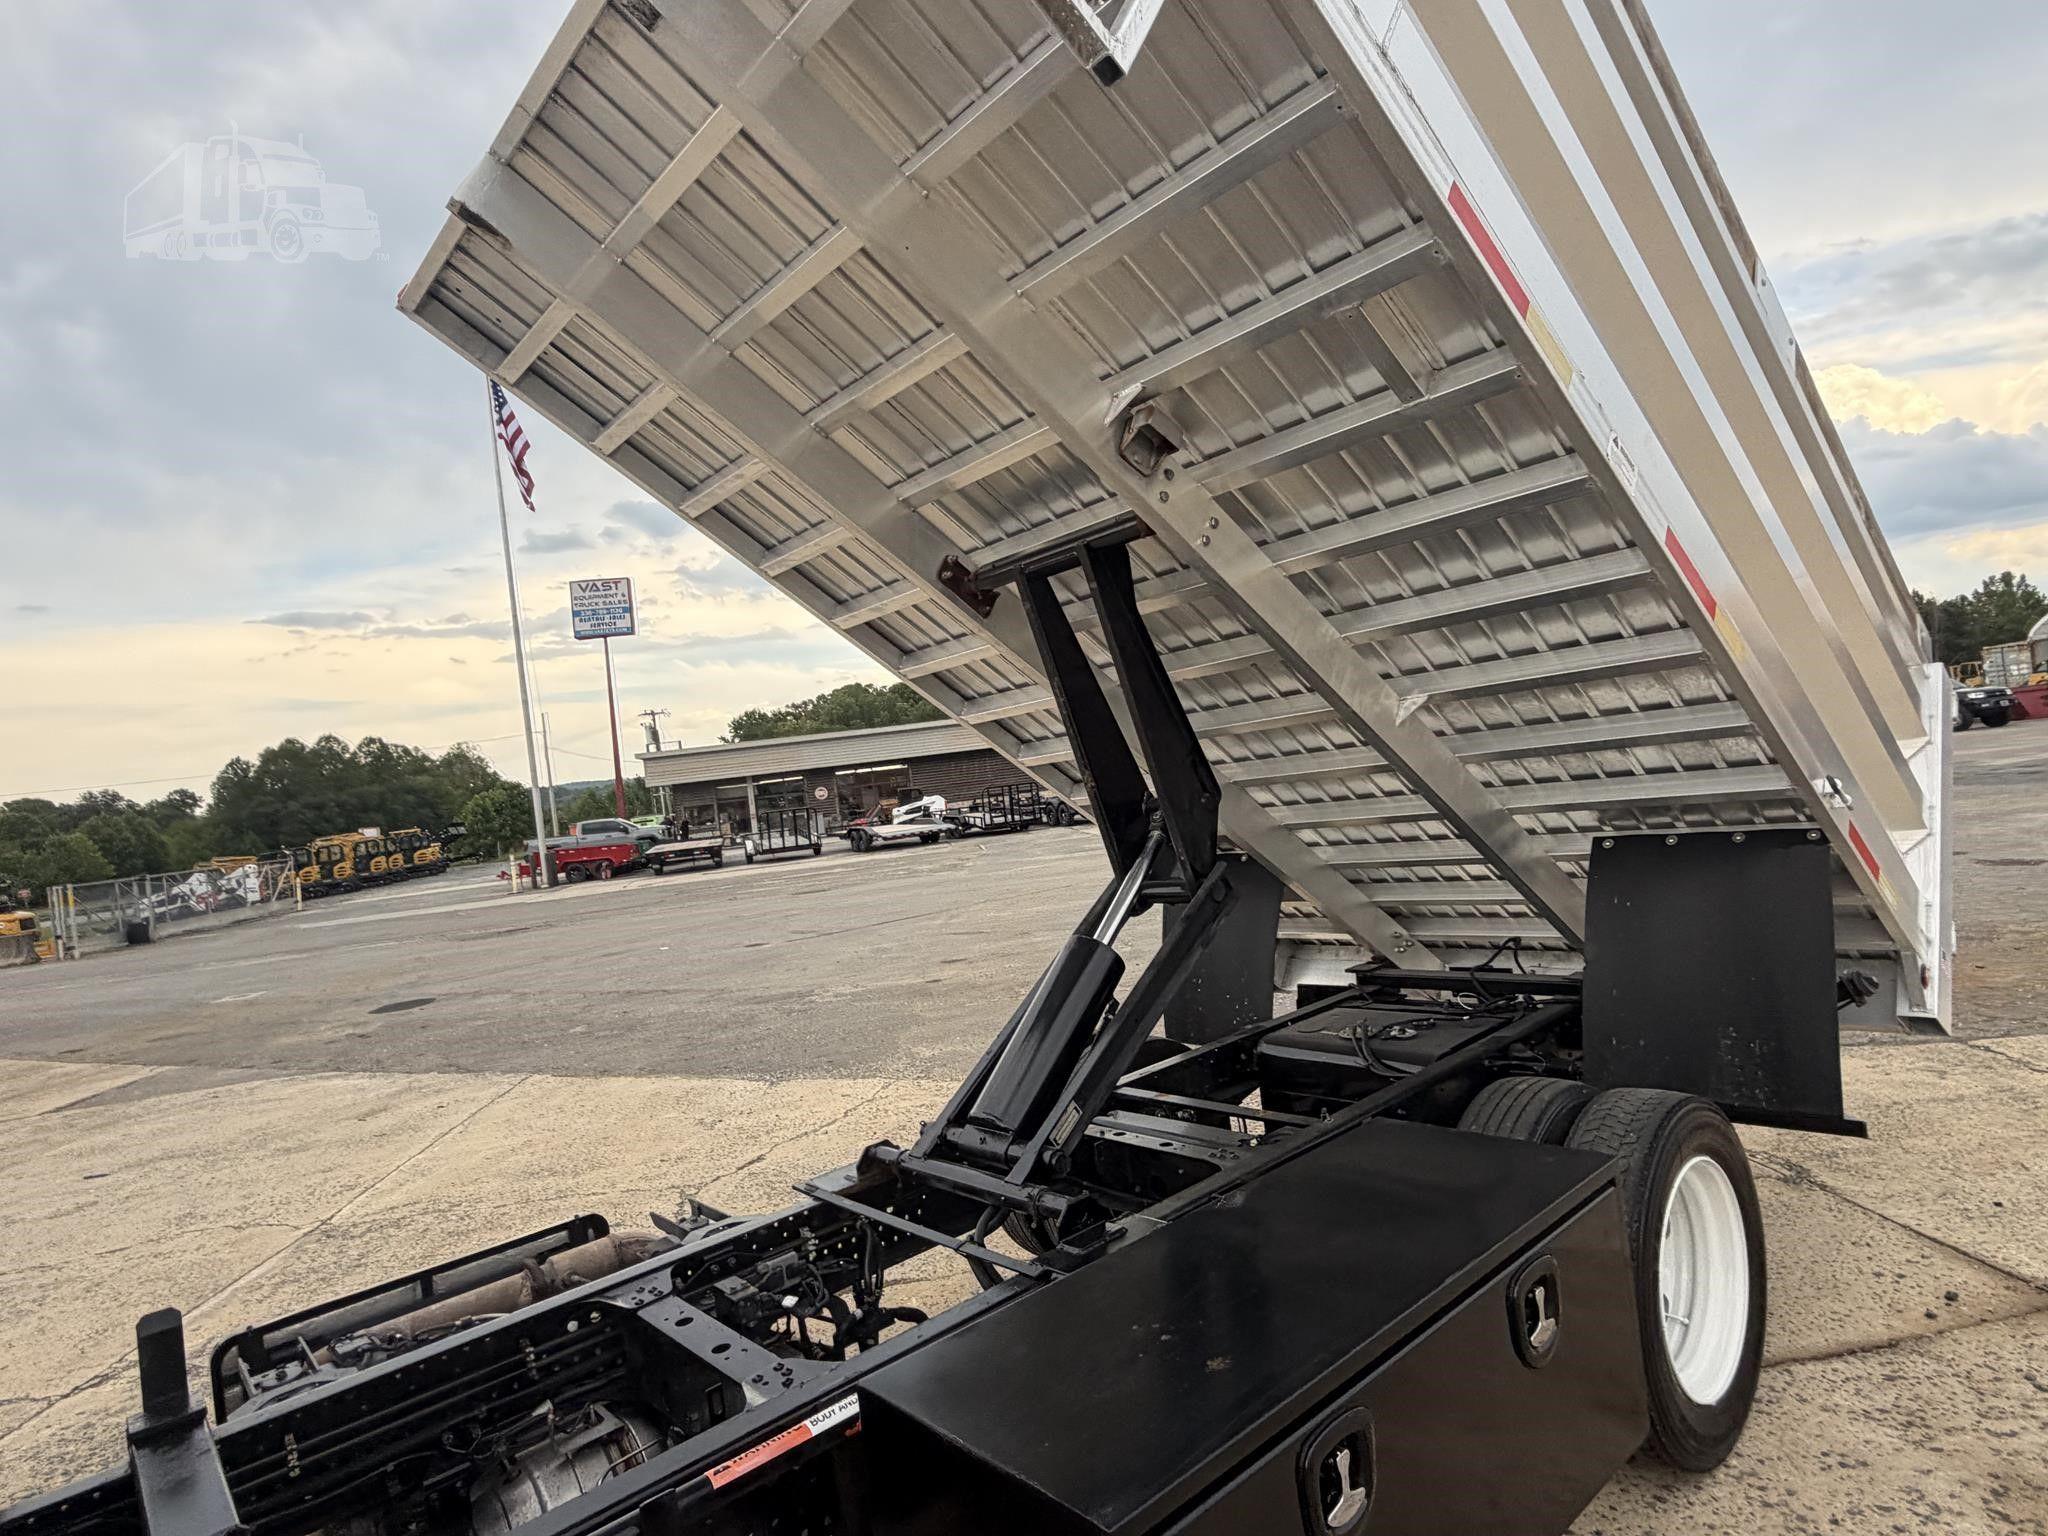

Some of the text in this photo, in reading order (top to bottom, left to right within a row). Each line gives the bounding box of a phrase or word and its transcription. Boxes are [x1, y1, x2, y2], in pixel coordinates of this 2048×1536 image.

[577, 581, 621, 593] VAST
[573, 593, 619, 602] EQUIPMENT
[574, 601, 600, 609] TRUCK
